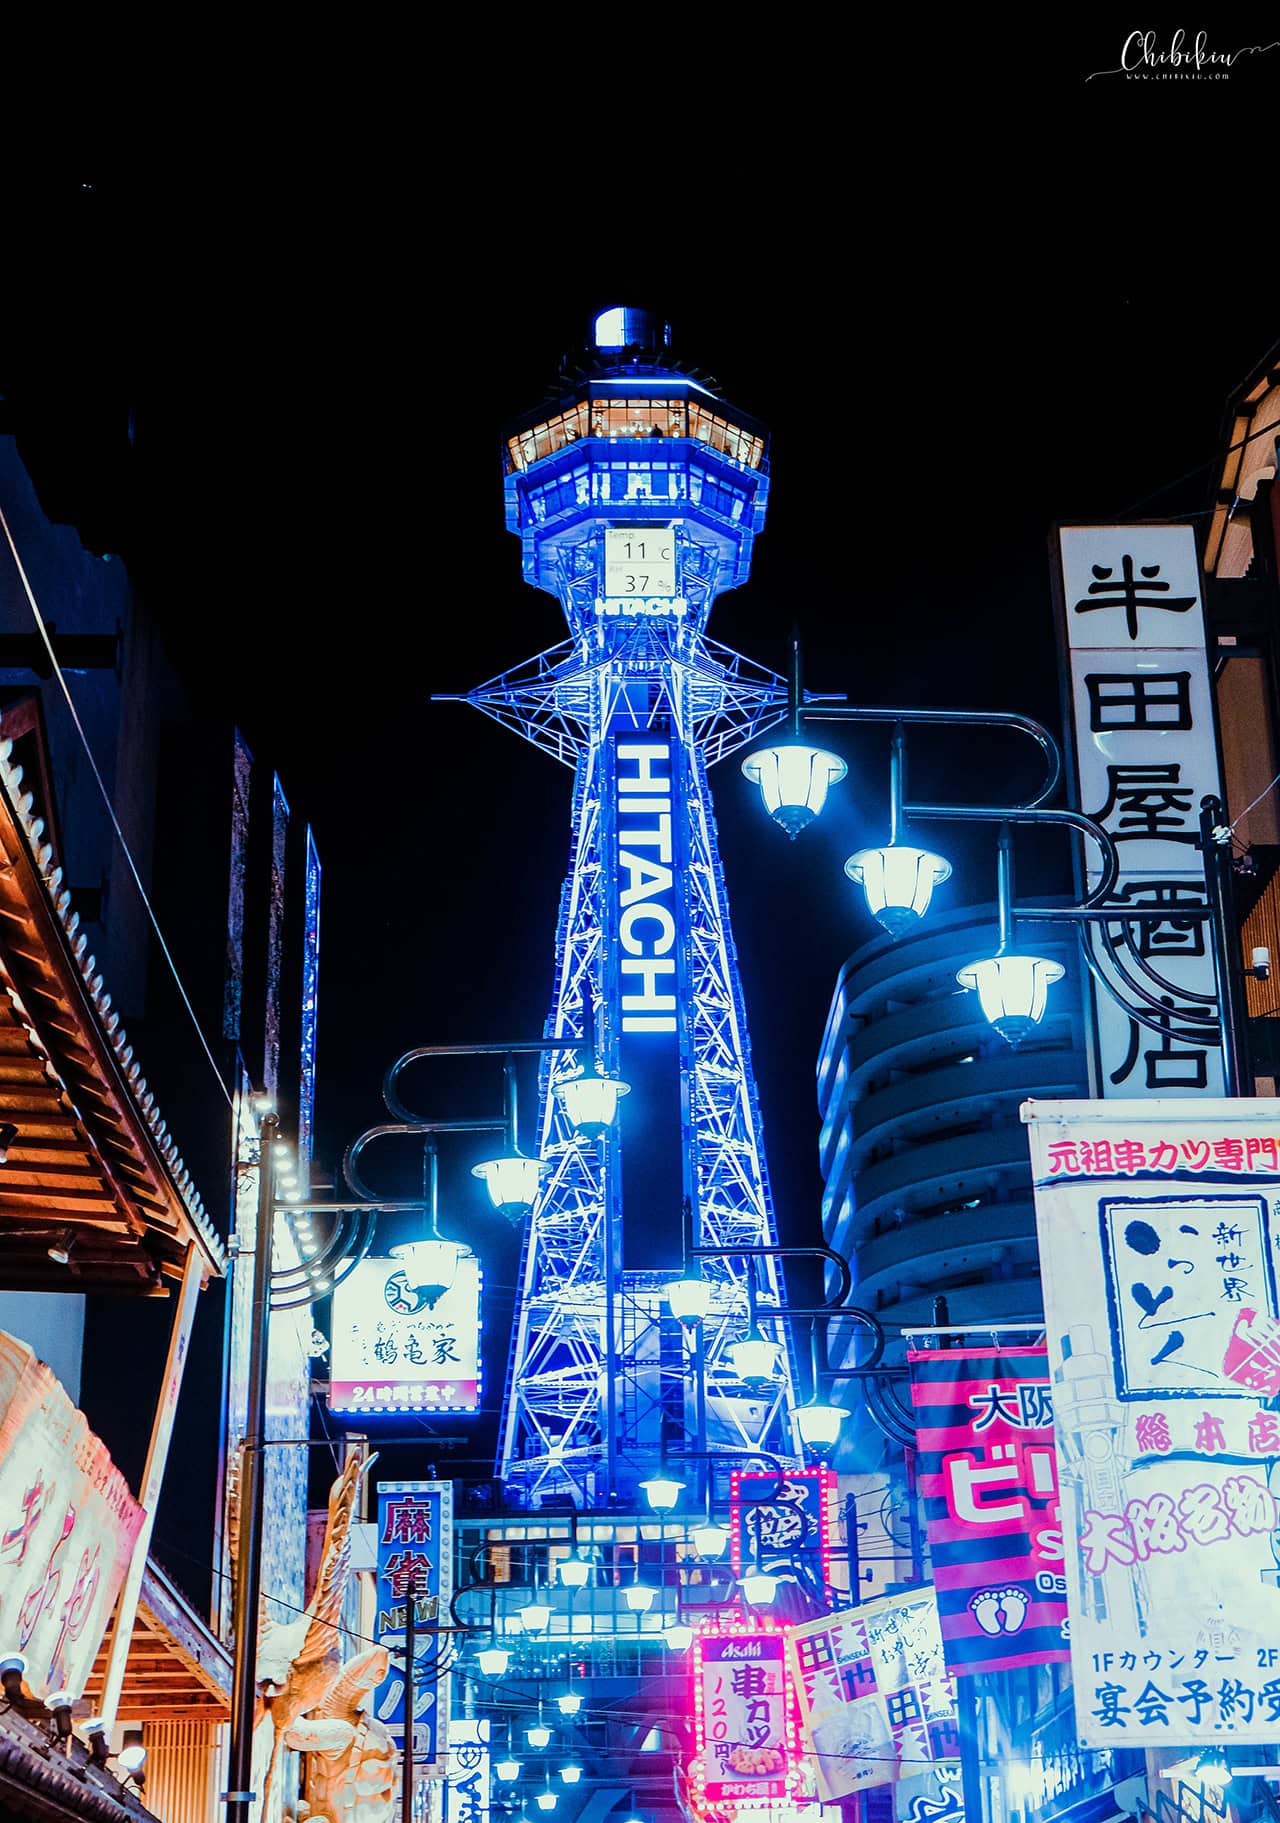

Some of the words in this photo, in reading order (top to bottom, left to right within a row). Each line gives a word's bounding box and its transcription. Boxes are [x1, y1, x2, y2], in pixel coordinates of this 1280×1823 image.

[624, 542, 645, 560] 11
[625, 575, 649, 593] 37
[594, 598, 687, 616] HITACHI
[1074, 554, 1209, 1090] 半田屋酒店
[617, 744, 677, 1033] HITACHI
[1047, 1137, 1280, 1174] 元祖串カツ専門
[1212, 1222, 1256, 1303] 新世界
[374, 1332, 462, 1366] 鶴亀家
[970, 1386, 1054, 1432] 大阪
[381, 1496, 433, 1598] 麻雀
[379, 1597, 439, 1633] NEW
[721, 1641, 762, 1658] Asahi
[1092, 1650, 1235, 1673] 1Fカウンター
[1257, 1648, 1279, 1668] 2F
[731, 1664, 771, 1750] 串カツ
